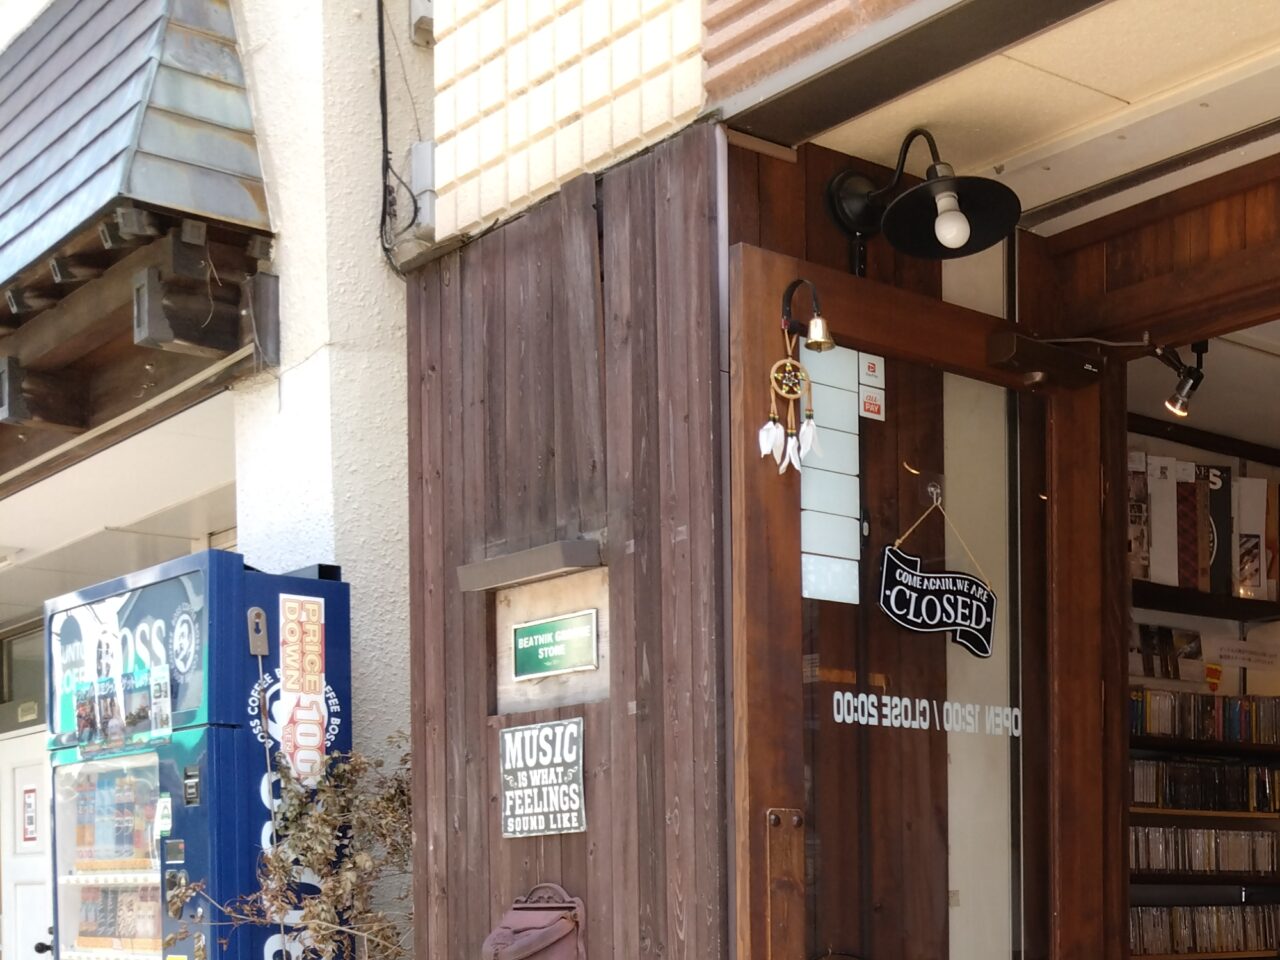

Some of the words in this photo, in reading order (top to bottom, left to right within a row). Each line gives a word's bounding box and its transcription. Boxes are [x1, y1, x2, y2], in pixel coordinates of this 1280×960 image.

[865, 402, 880, 413] PAY
[895, 569, 922, 590] COME
[956, 577, 970, 592] WE
[970, 583, 989, 602] ARE
[889, 584, 988, 631] CLOSED
[282, 601, 302, 692] DOWN
[303, 601, 324, 694] PRICE
[518, 631, 553, 649] BEATNIK
[538, 644, 567, 660] STORE
[504, 723, 578, 770] MUSIC
[517, 771, 528, 788] IS
[530, 767, 564, 788] WHAT
[505, 783, 580, 816] FEELINGS
[507, 814, 546, 832] SOUND
[549, 812, 579, 829] LIKE
